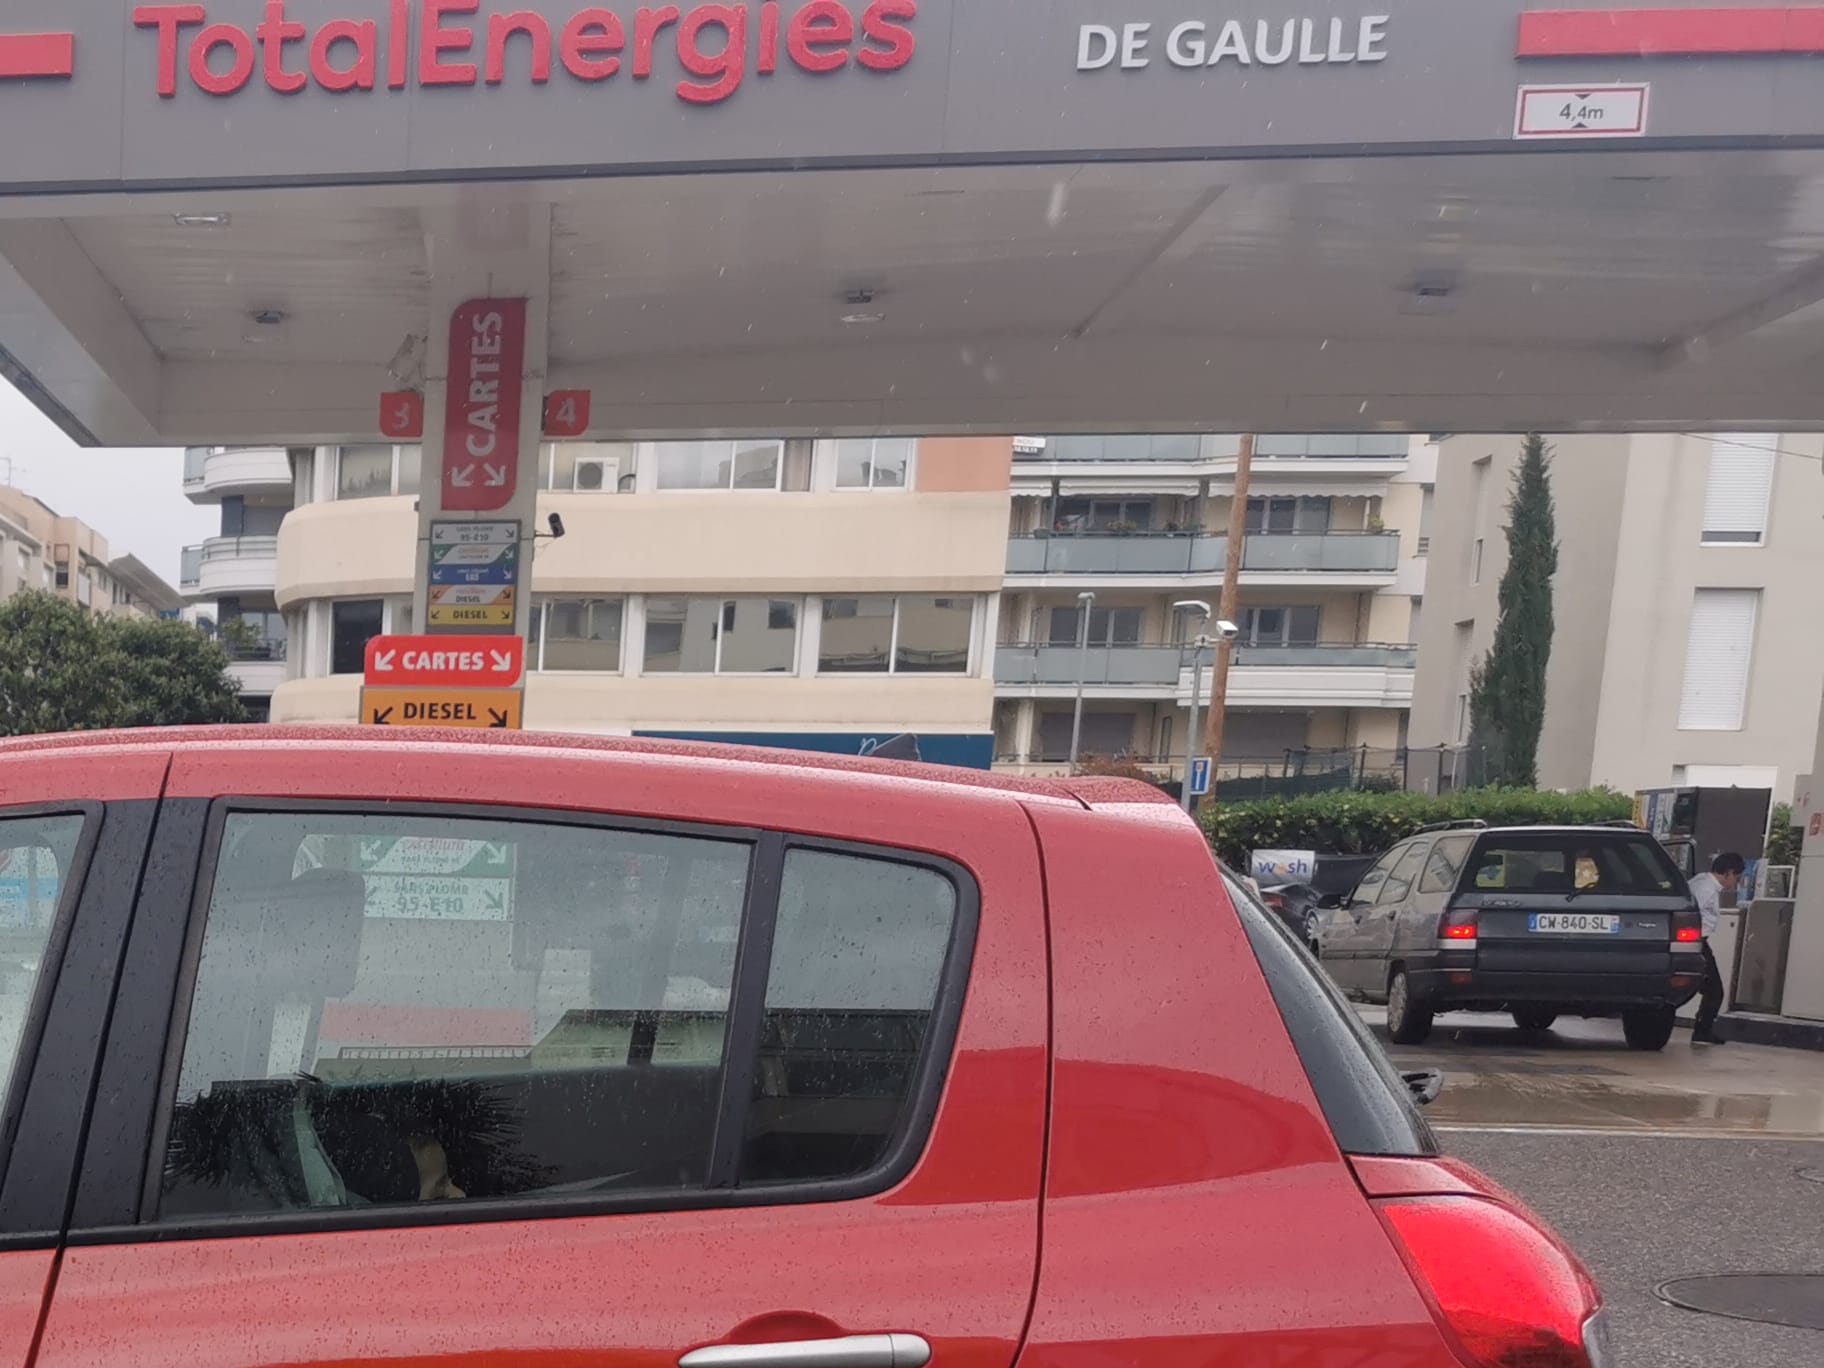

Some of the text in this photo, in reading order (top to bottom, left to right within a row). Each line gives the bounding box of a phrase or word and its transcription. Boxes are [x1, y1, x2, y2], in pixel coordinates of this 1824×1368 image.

[133, 0, 917, 104] TotalEnergies
[1077, 15, 1389, 71] DE GAULLE
[1559, 102, 1604, 123] 4,4m
[466, 312, 502, 456] CARTES
[392, 403, 409, 430] 3
[556, 399, 575, 427] 4
[452, 610, 488, 619] DIESEL
[402, 651, 484, 670] CARTES
[404, 701, 476, 720] DIESEL
[1538, 915, 1608, 930] CW-840-SL
